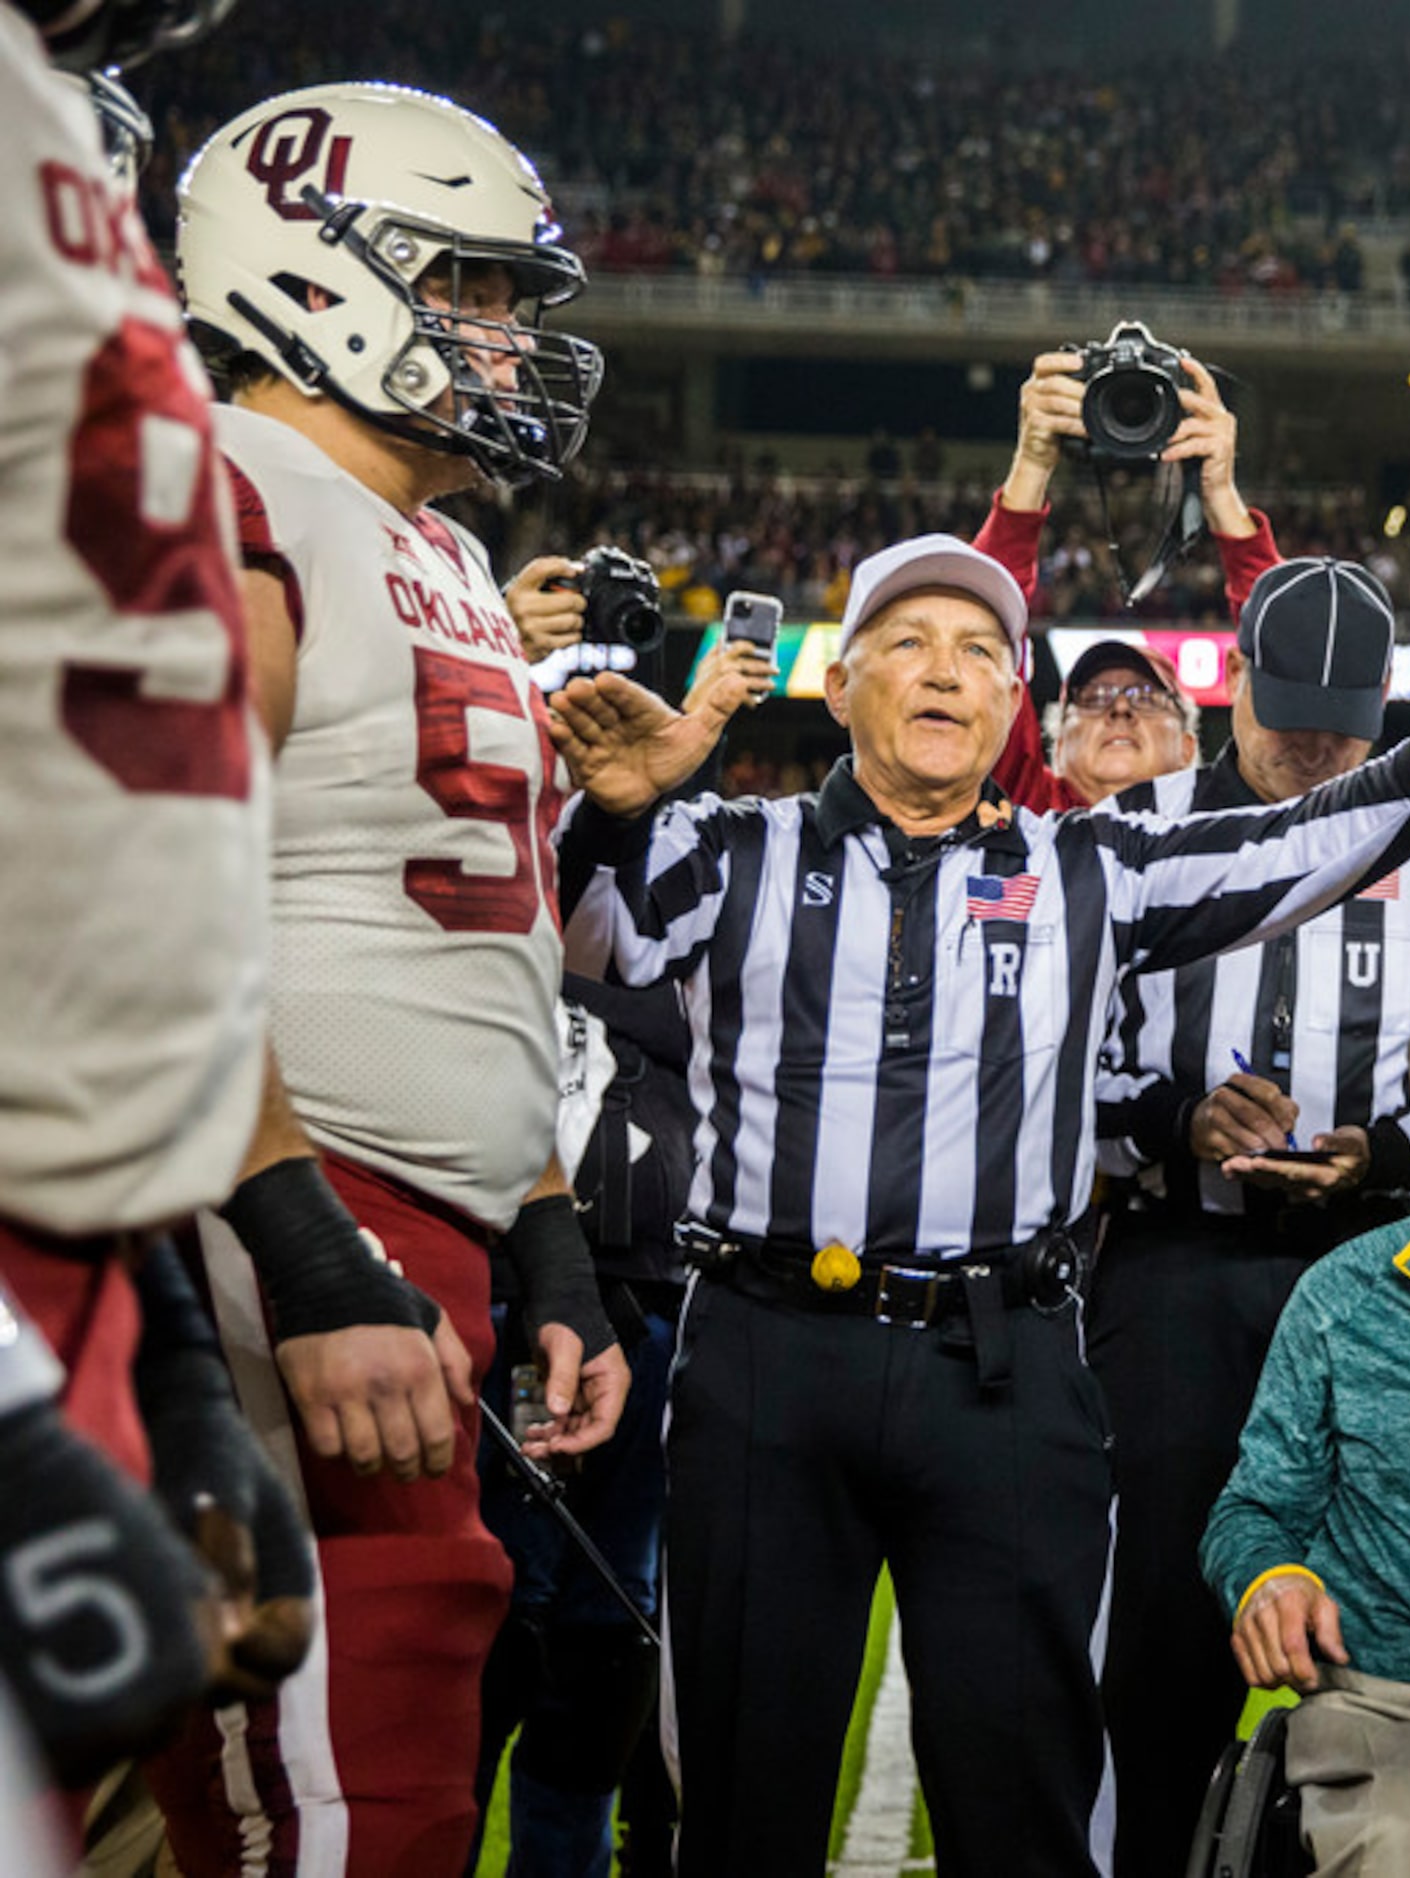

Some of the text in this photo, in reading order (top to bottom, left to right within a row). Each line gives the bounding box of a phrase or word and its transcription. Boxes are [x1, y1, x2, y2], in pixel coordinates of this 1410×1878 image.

[245, 107, 354, 222] OU
[989, 942, 1021, 997] R
[1345, 942, 1381, 988] U
[5, 1518, 149, 1703] 5
